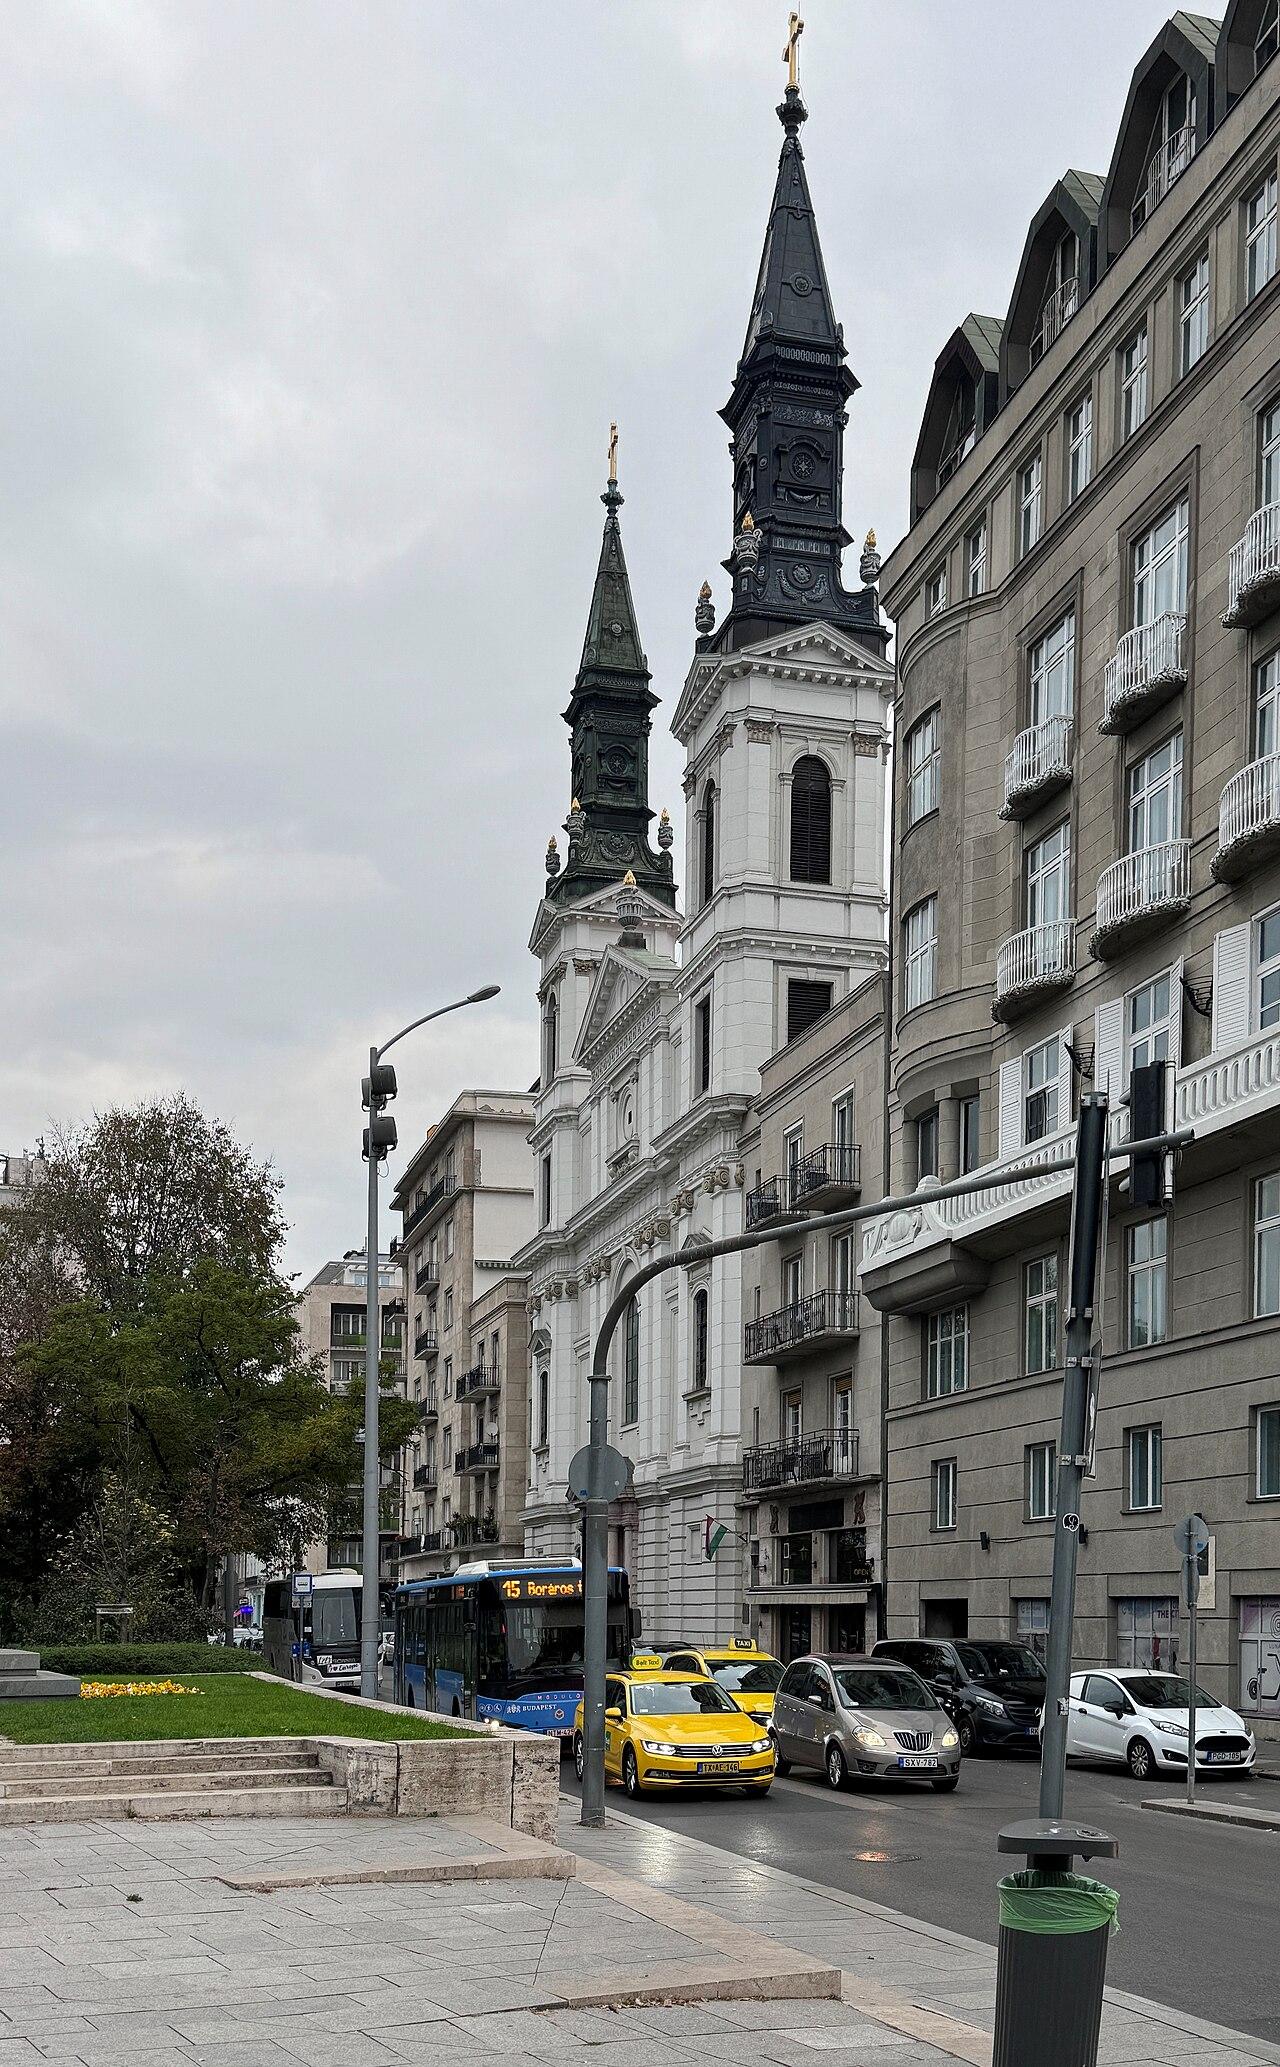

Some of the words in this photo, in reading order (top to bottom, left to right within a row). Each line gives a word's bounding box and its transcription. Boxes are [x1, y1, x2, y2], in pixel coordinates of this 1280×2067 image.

[502, 1580, 520, 1598] 15
[527, 1581, 574, 1596] Boráros
[1157, 1610, 1169, 1618] THE
[736, 1639, 751, 1647] TAXI
[522, 1703, 557, 1712] BUDAPEST
[905, 1758, 936, 1767] SXV-782
